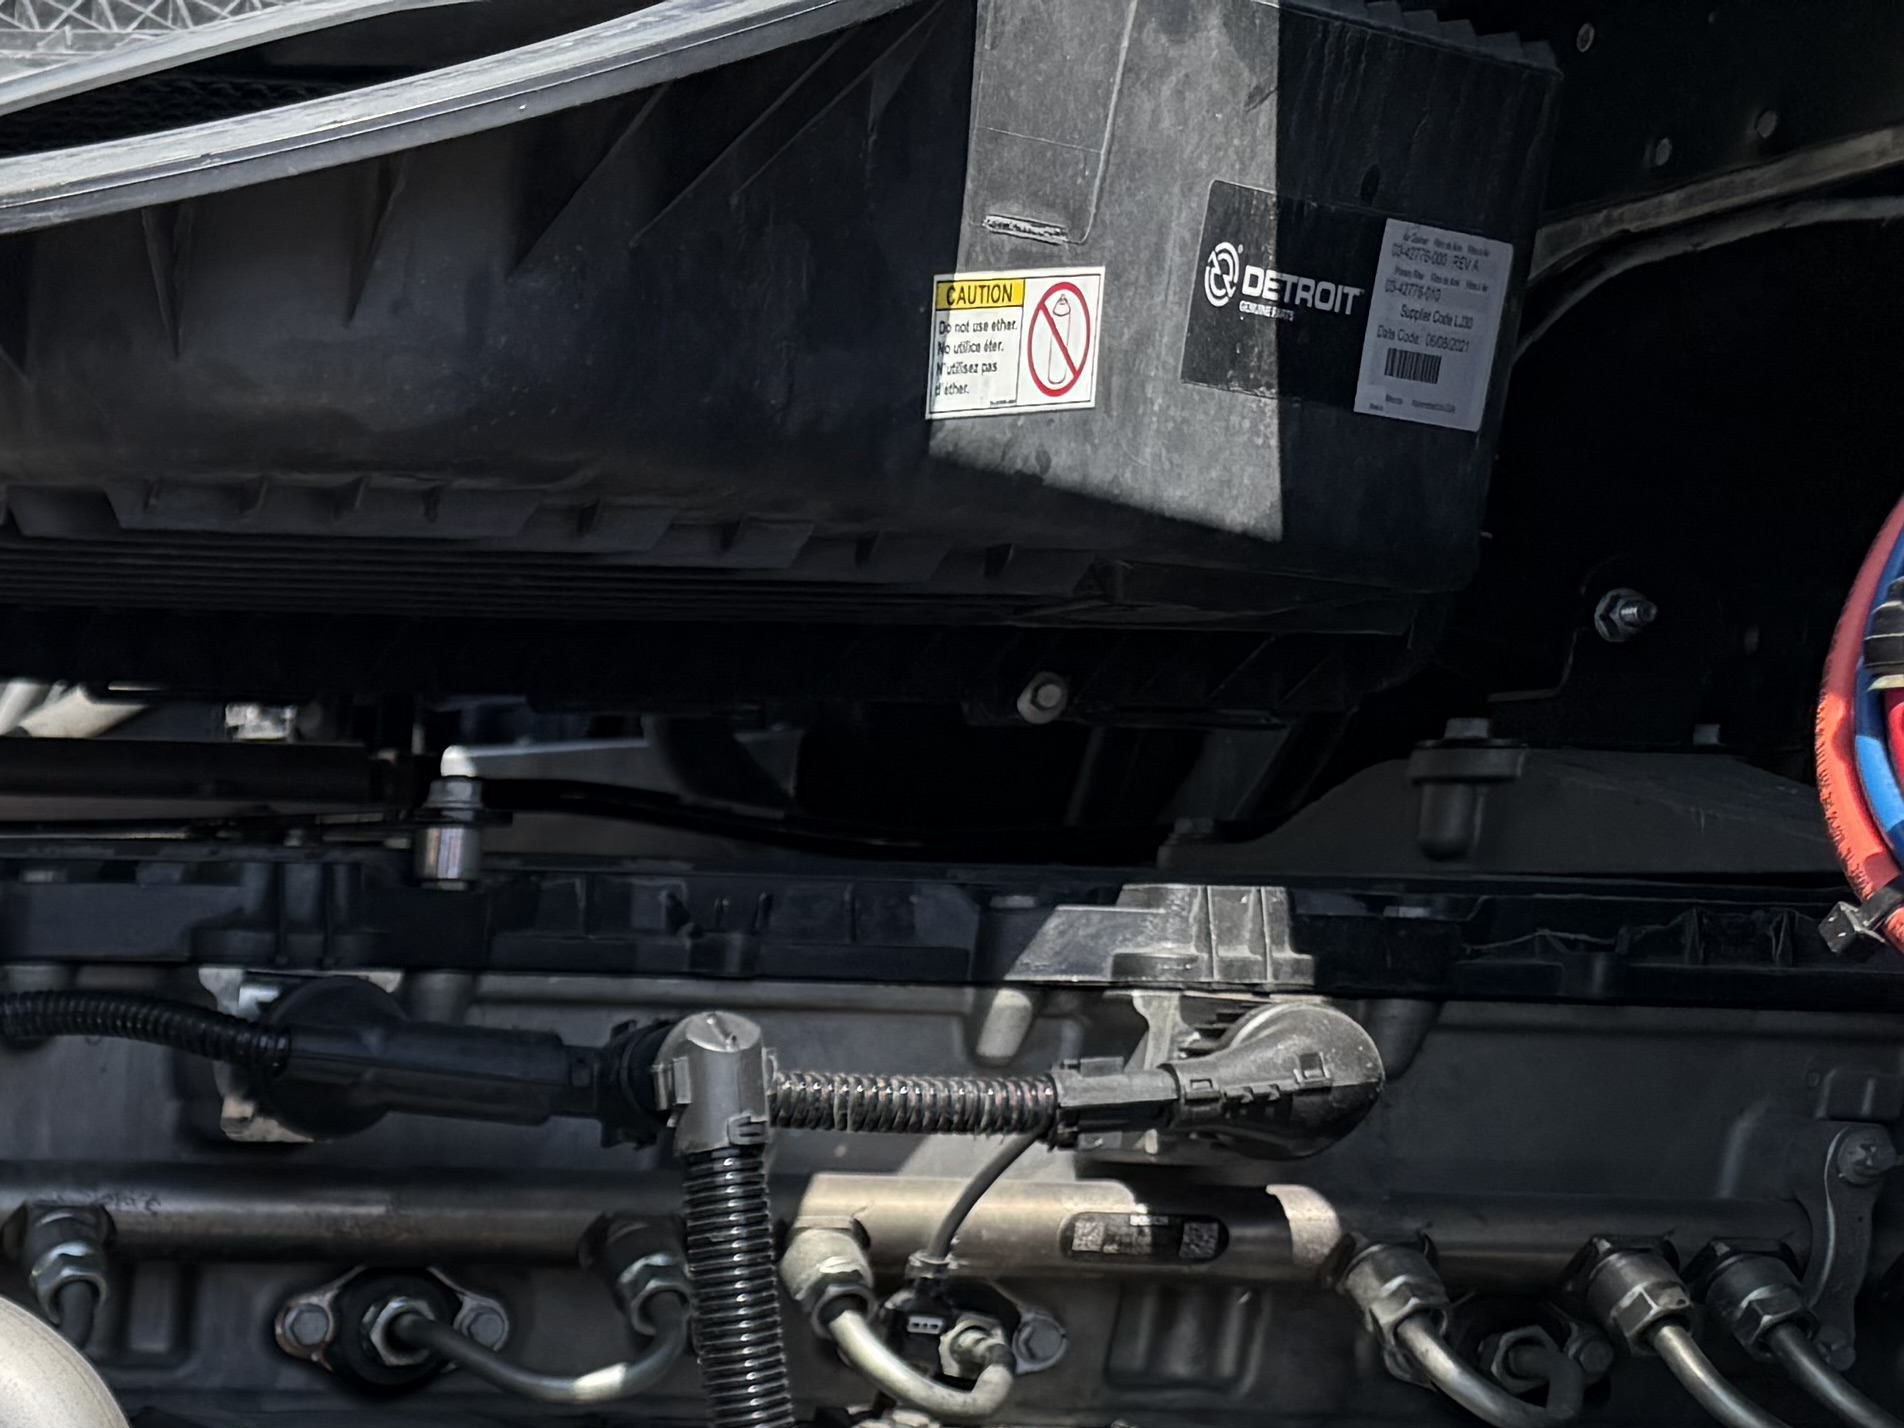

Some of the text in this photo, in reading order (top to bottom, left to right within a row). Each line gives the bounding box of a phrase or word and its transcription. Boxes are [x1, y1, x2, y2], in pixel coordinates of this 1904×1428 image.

[946, 284, 1012, 305] CAUTION
[1242, 265, 1361, 315] DETROIT
[1400, 304, 1453, 326] Supplier Code
[939, 319, 1017, 334] Do not use ether.
[1377, 325, 1395, 341] Date
[938, 342, 950, 355] No
[981, 363, 998, 377] pas
